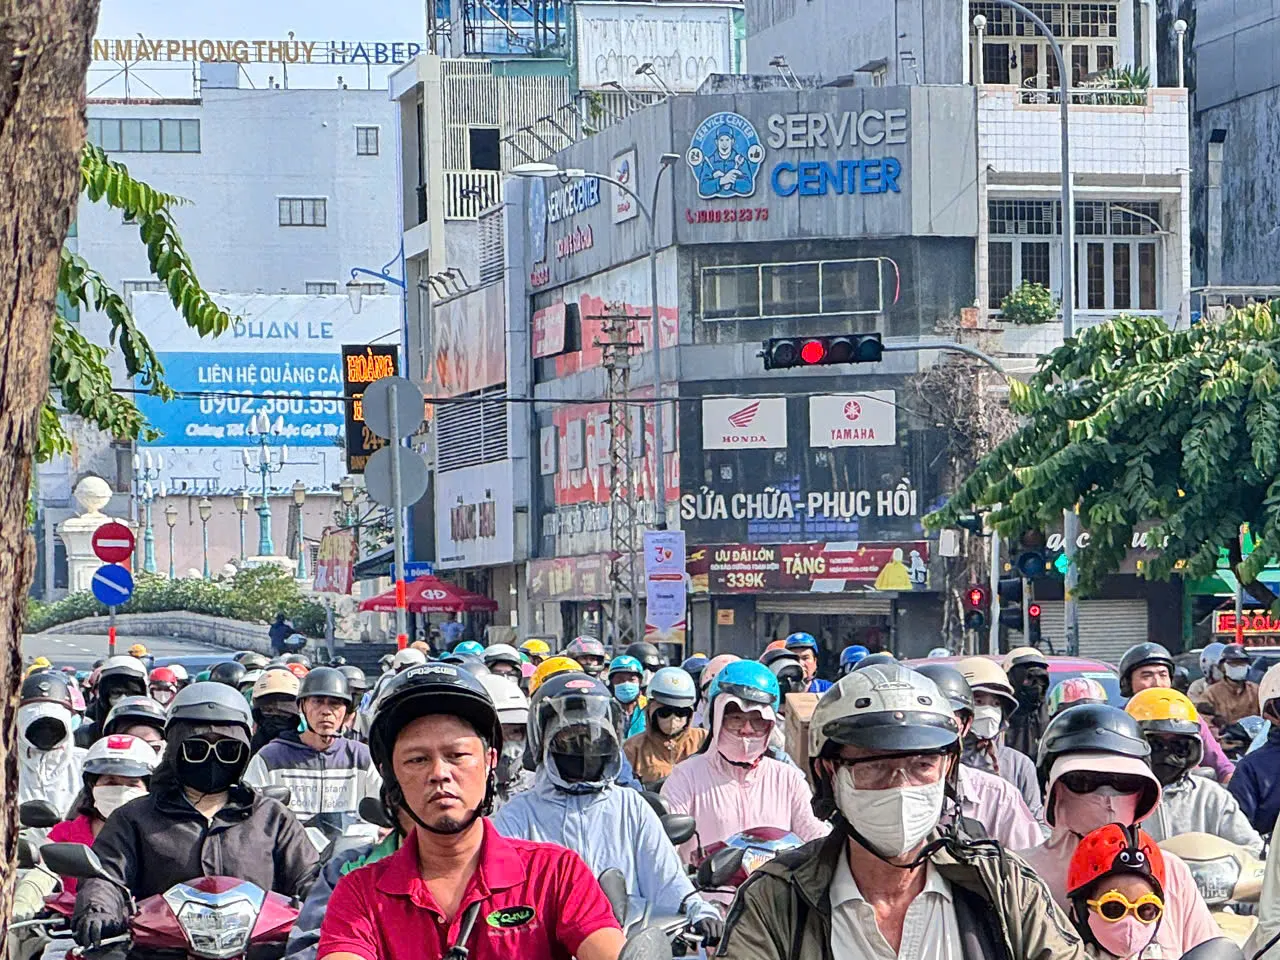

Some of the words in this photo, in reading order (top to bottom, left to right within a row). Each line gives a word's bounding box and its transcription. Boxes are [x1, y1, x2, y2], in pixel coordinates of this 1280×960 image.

[114, 32, 162, 61] MÀY
[167, 39, 249, 63] PHONG
[252, 31, 316, 63] THỦY
[767, 109, 908, 149] SERVICE
[771, 157, 902, 197] CENTER
[307, 321, 334, 339] LE
[199, 363, 233, 383] LIÊN
[236, 364, 258, 386] HỆ
[260, 362, 315, 384] QUẢNG
[318, 364, 345, 383] CÁ
[346, 346, 394, 383] HOÀNG
[831, 428, 875, 440] YAMAHA
[680, 485, 728, 520] SỬA
[731, 486, 794, 519] CHỮA
[808, 490, 871, 523] PHỤC
[877, 475, 917, 517] HỒI
[732, 547, 751, 562] ĐÃI
[753, 546, 775, 561] LỚN
[782, 552, 826, 580] TẶNG
[726, 572, 765, 588] 339K
